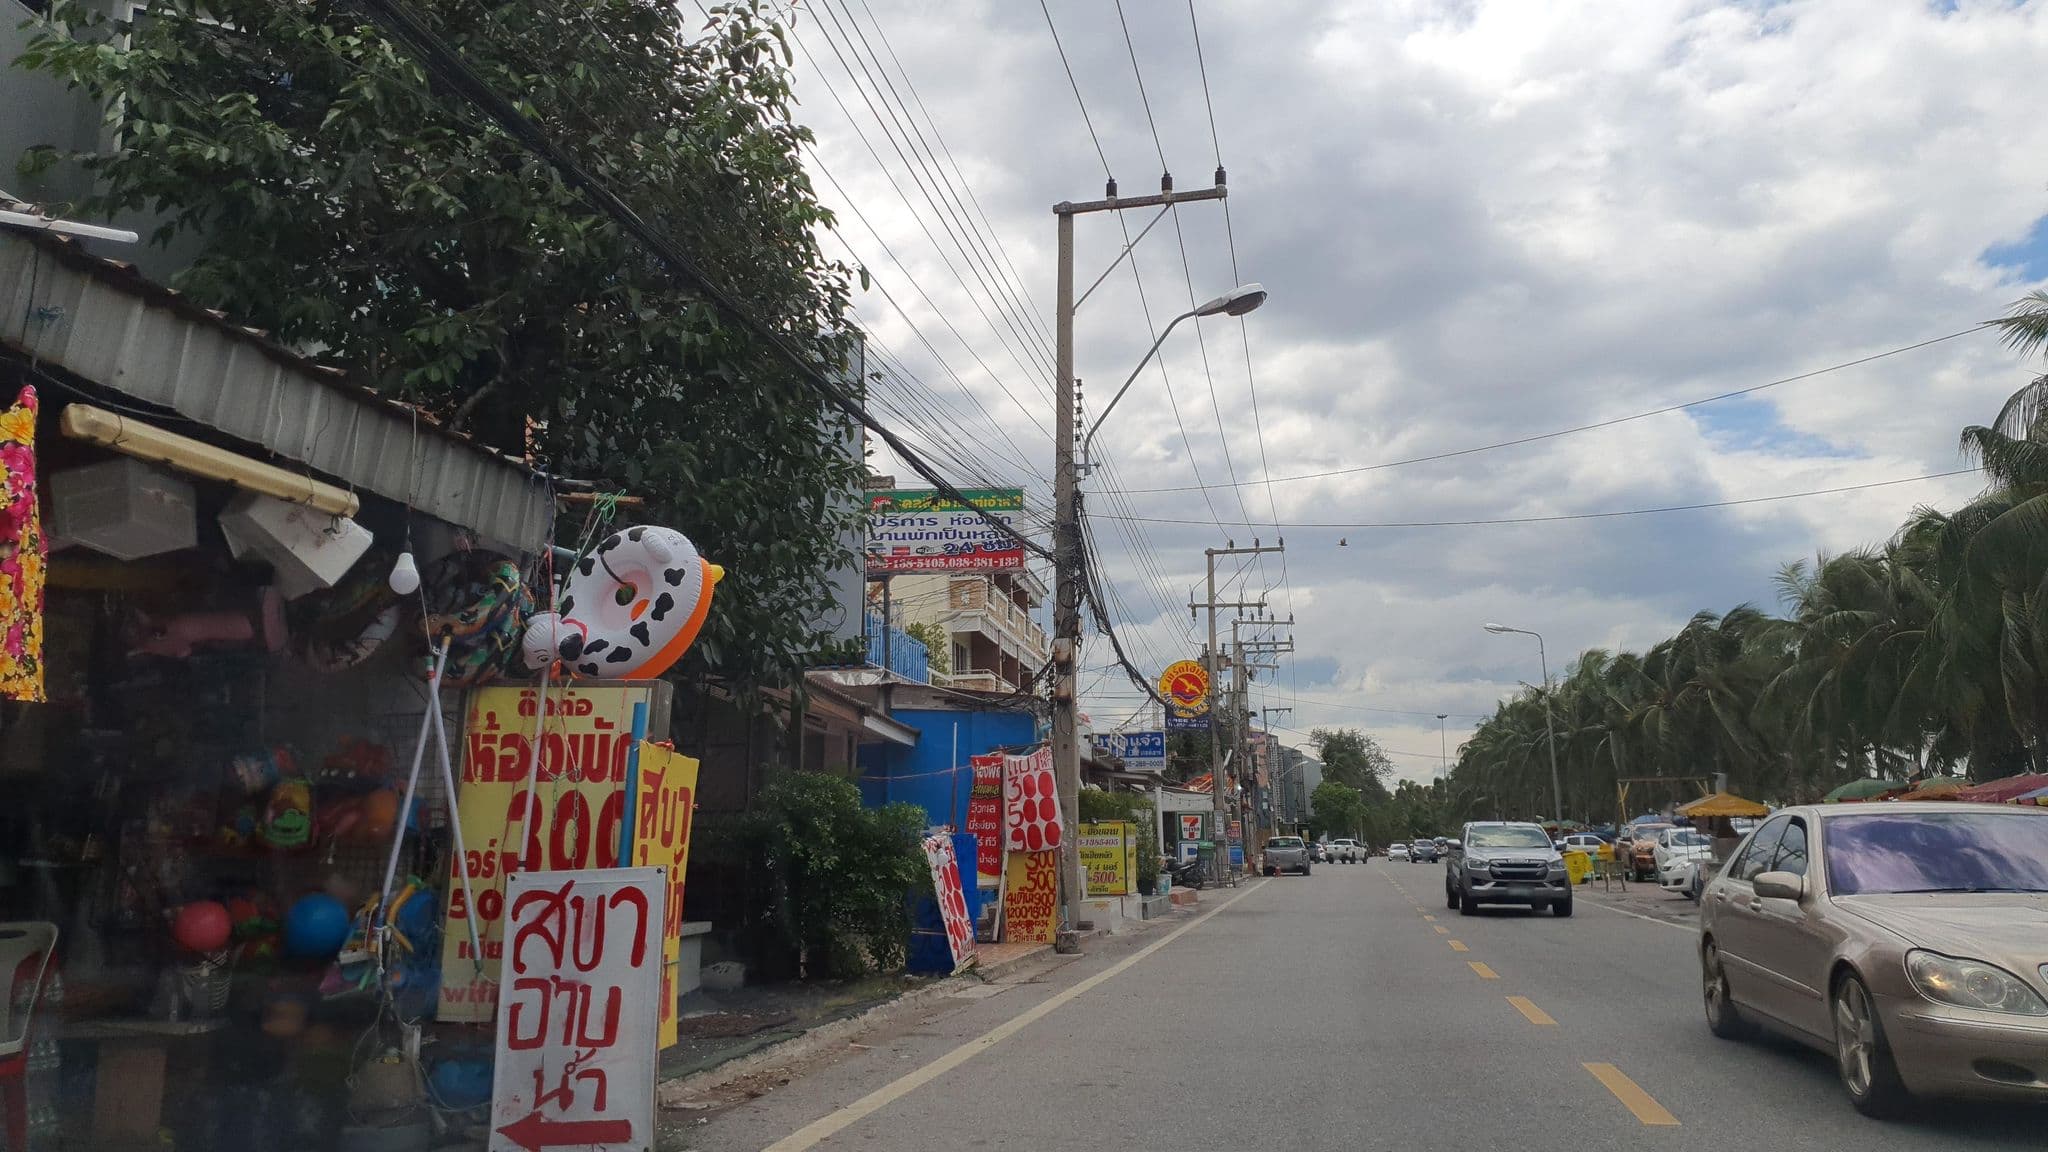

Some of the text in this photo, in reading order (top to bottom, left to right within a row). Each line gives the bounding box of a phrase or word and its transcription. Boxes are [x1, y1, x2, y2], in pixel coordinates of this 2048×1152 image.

[950, 512, 1012, 526] ห้องัก
[943, 541, 974, 555] 24
[518, 690, 593, 716] ติดต่อ
[1008, 771, 1054, 802] 300
[1008, 798, 1056, 828] 500
[1010, 821, 1061, 852] 900
[1026, 869, 1056, 892] 500
[508, 975, 621, 1050] อาบ
[533, 1048, 607, 1112] น้ำ
